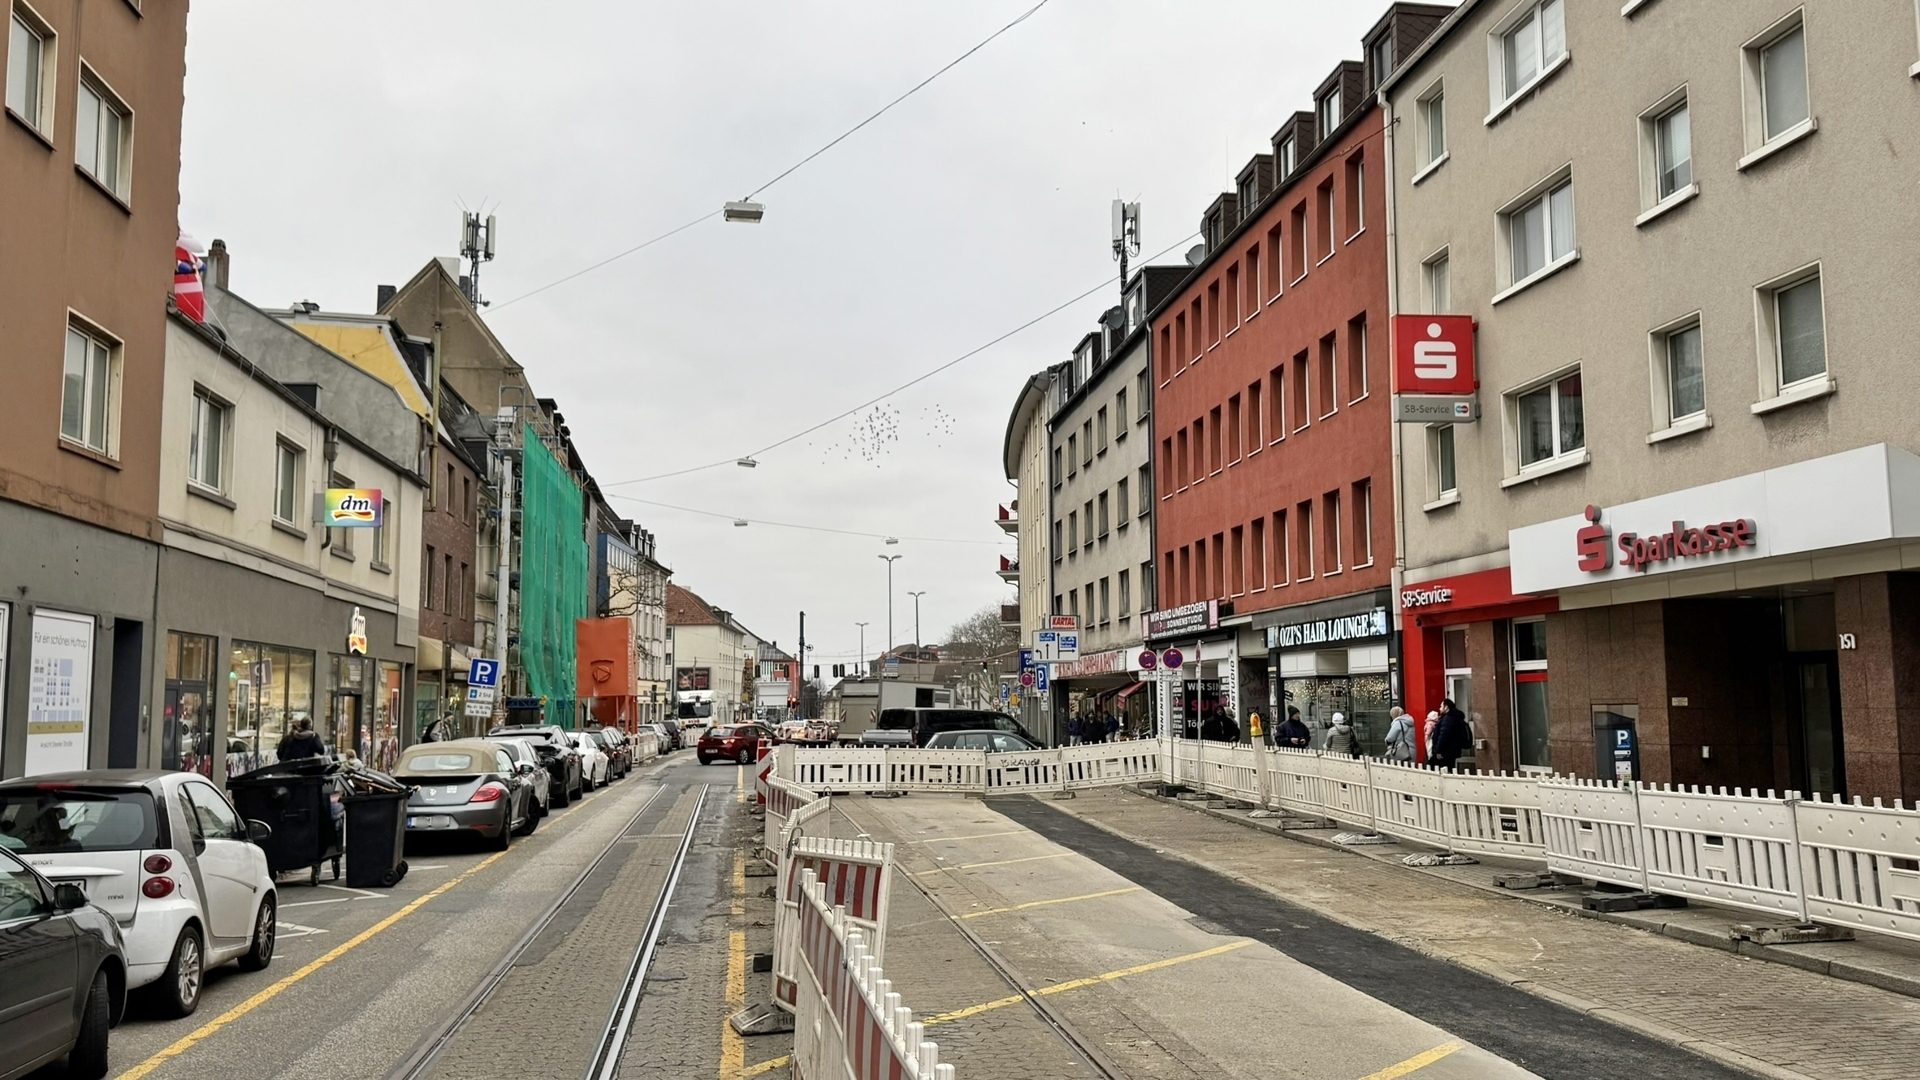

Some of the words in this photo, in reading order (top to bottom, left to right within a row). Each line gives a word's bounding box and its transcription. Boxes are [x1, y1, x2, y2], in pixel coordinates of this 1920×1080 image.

[1405, 404, 1450, 414] SB-Service
[341, 496, 369, 510] dm
[1618, 518, 1757, 573] Sparkasse
[1402, 588, 1451, 608] SB-Service
[1150, 611, 1160, 623] WIR
[1160, 608, 1172, 620] SIND
[1172, 600, 1207, 618] UMGEZOGEN
[1052, 617, 1075, 626] KARTAL
[1167, 614, 1203, 628] SONNENSTUDIO
[1280, 625, 1302, 647] OZI'S
[1303, 621, 1327, 644] HAIR
[1328, 614, 1369, 641] LOUNGE
[1839, 633, 1856, 649] 151
[475, 662, 492, 682] P
[1187, 683, 1205, 691] WIR
[1617, 730, 1628, 745] P
